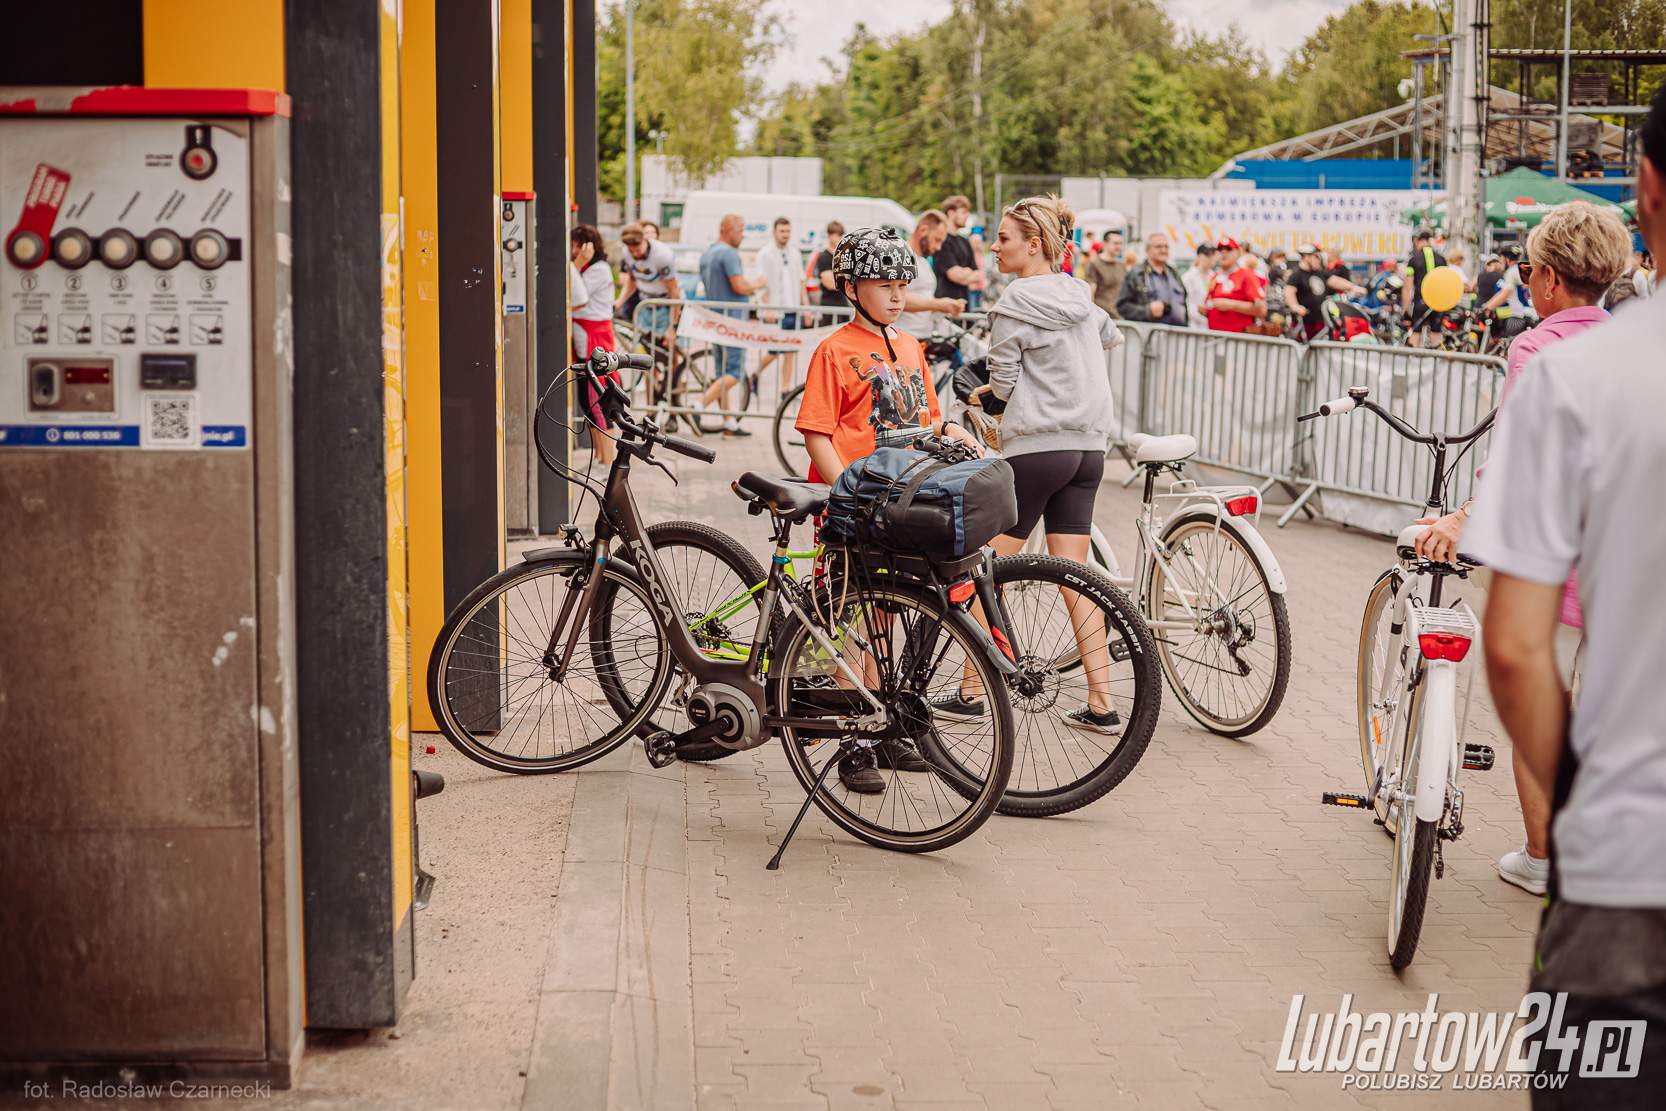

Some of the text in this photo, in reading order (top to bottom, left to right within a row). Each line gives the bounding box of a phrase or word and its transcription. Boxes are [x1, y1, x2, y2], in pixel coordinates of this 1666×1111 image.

[1312, 211, 1380, 222] EUROPIE
[629, 539, 674, 627] KOGA
[1063, 573, 1143, 654] CST JACK RABBIT
